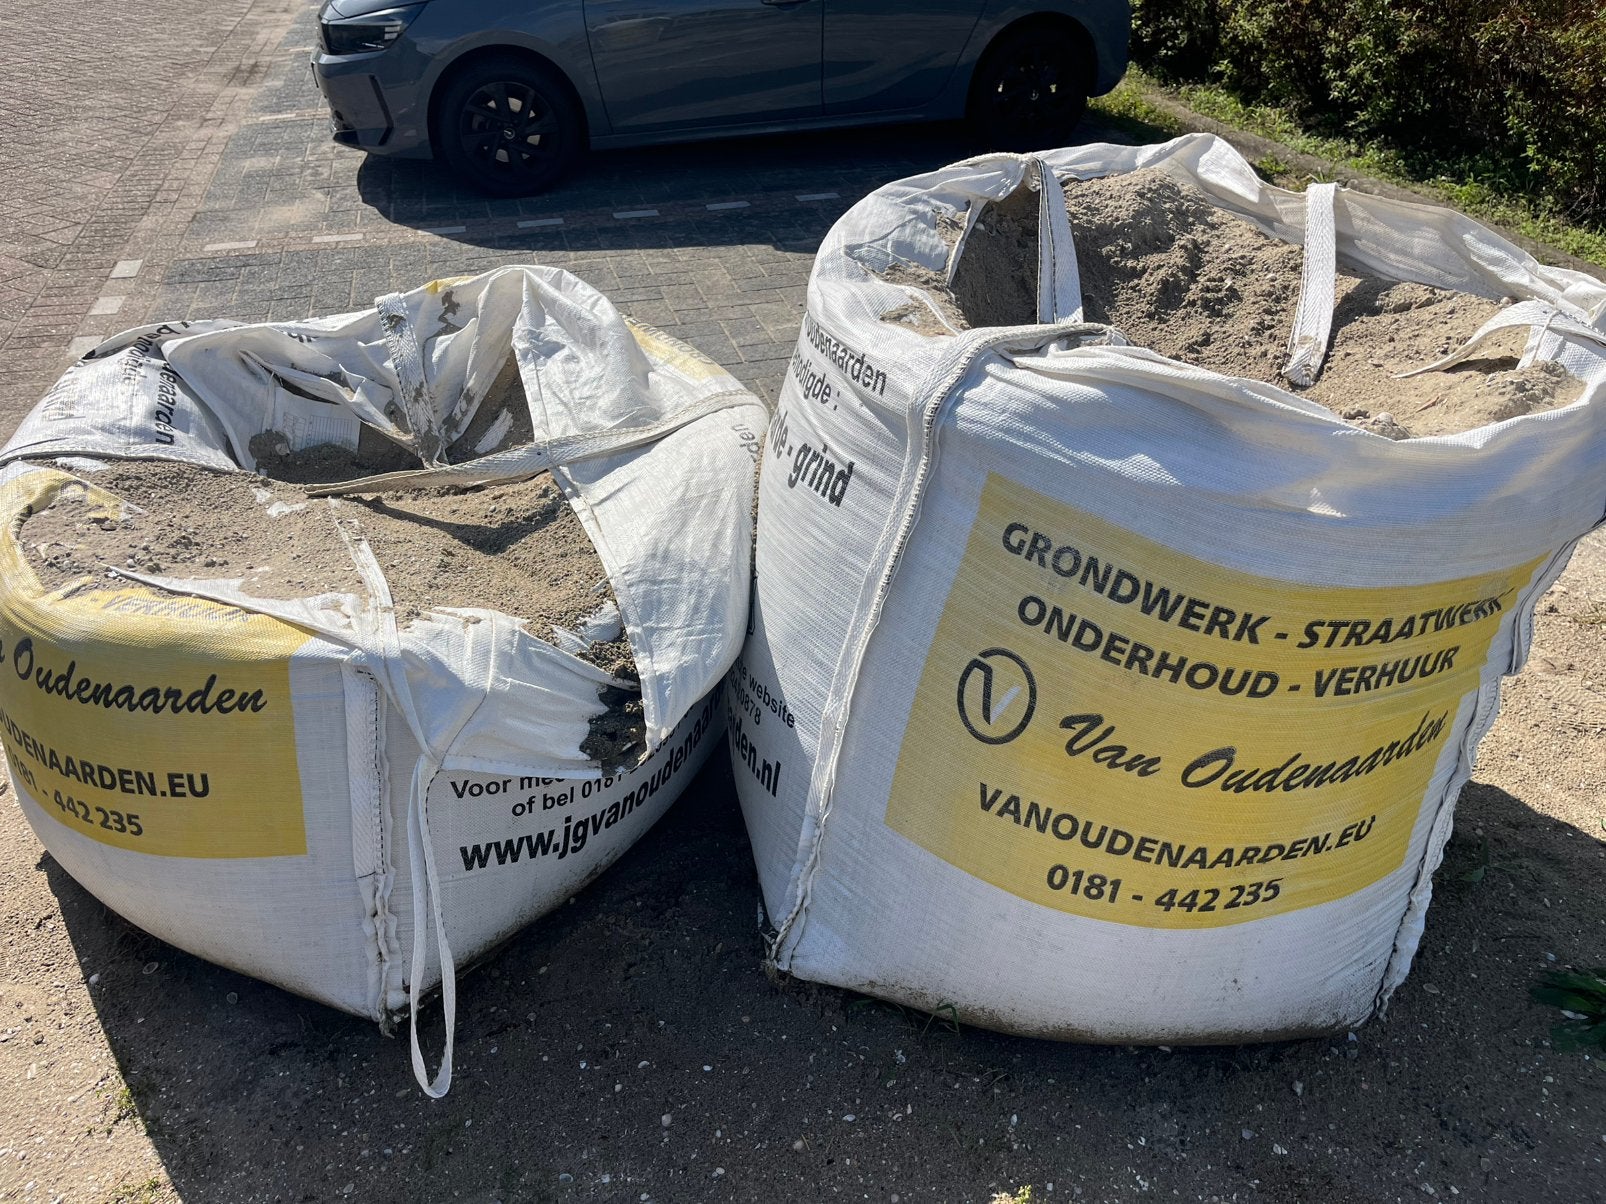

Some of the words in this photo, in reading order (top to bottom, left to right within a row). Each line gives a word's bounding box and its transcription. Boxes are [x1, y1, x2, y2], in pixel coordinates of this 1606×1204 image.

[788, 443, 855, 507] grind
[1002, 521, 1271, 645] GRONDWERK
[1296, 587, 1515, 650] STRAATWERK
[13, 636, 267, 714] Oudenaarden
[1017, 594, 1280, 698] ONDERHOUD
[1313, 645, 1460, 698] VERHUUR
[748, 673, 796, 729] website
[1059, 712, 1161, 777] Van
[1180, 710, 1448, 793] Oudenaarden
[53, 788, 94, 824] 442
[95, 806, 144, 837] 235
[450, 779, 512, 799] Voor
[511, 795, 536, 817] of
[542, 786, 574, 811] bel
[979, 782, 1377, 870] VANOUDENAARDEN.EU
[1047, 863, 1122, 904] 0181
[1154, 886, 1218, 914] 442
[1223, 877, 1284, 910] 235
